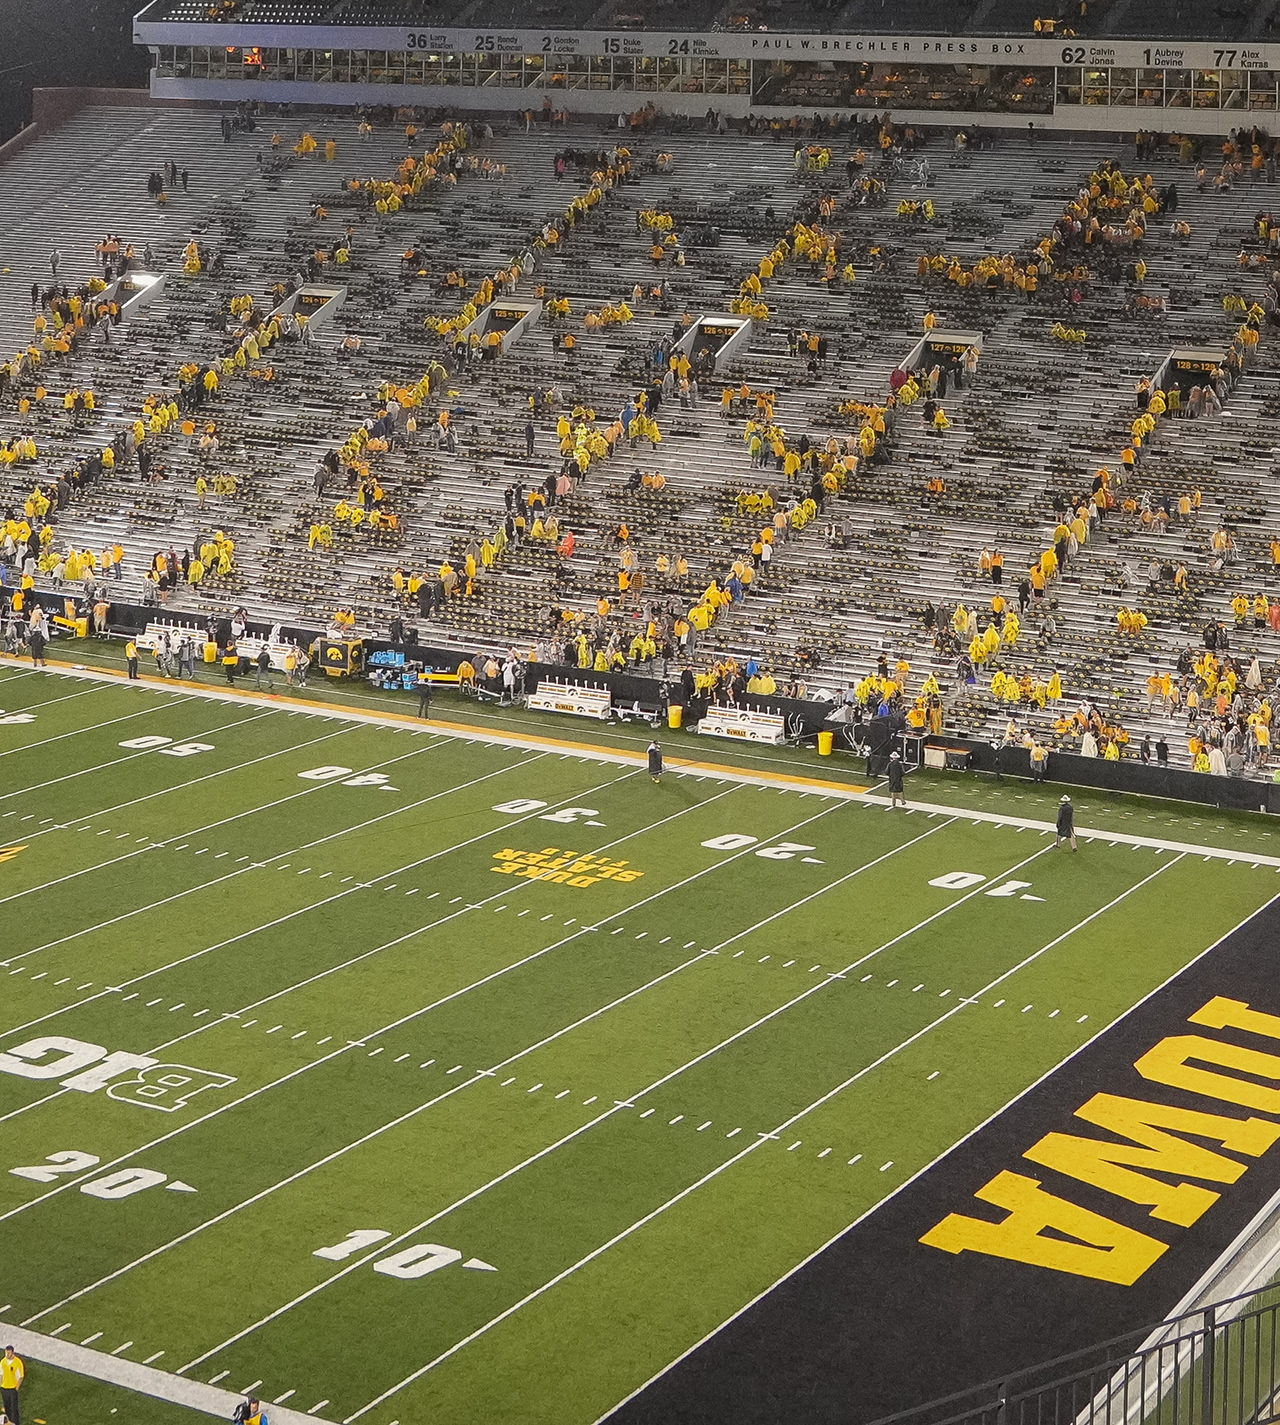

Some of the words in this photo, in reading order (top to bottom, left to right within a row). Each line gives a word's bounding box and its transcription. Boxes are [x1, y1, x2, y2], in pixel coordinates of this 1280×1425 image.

[407, 33, 427, 49] 36
[430, 34, 446, 42] Larry
[475, 36, 494, 51] 25
[498, 36, 517, 44] Randy
[542, 37, 552, 52] 2
[602, 38, 620, 54] 15
[752, 39, 793, 49] PAUL
[801, 40, 815, 49] W.
[822, 41, 911, 51] BRECHLER
[923, 42, 978, 52] PRESS
[992, 44, 1025, 53] BOX
[623, 46, 644, 54] Slater
[668, 39, 690, 55] 24
[1089, 48, 1115, 56] Calvin
[1154, 49, 1184, 58] Aubrey
[1241, 50, 1259, 59] Alex
[1061, 47, 1086, 64] 62
[1089, 57, 1115, 65] Jones
[1143, 48, 1151, 65] 1
[1154, 58, 1183, 66] Devine
[1213, 50, 1237, 67] 77
[1241, 60, 1269, 68] Karras
[704, 326, 717, 334] 126
[952, 345, 966, 353] 128
[1177, 361, 1191, 369] 128
[118, 735, 215, 757] 50
[298, 766, 391, 786] 40
[492, 799, 600, 823] 30
[700, 834, 818, 860] 20
[493, 848, 644, 882] SLATER
[541, 847, 629, 867] FIELD
[490, 862, 602, 888] DUKE
[928, 871, 1029, 897] 10
[10, 1151, 168, 1199] 20
[313, 1230, 463, 1278] 10
